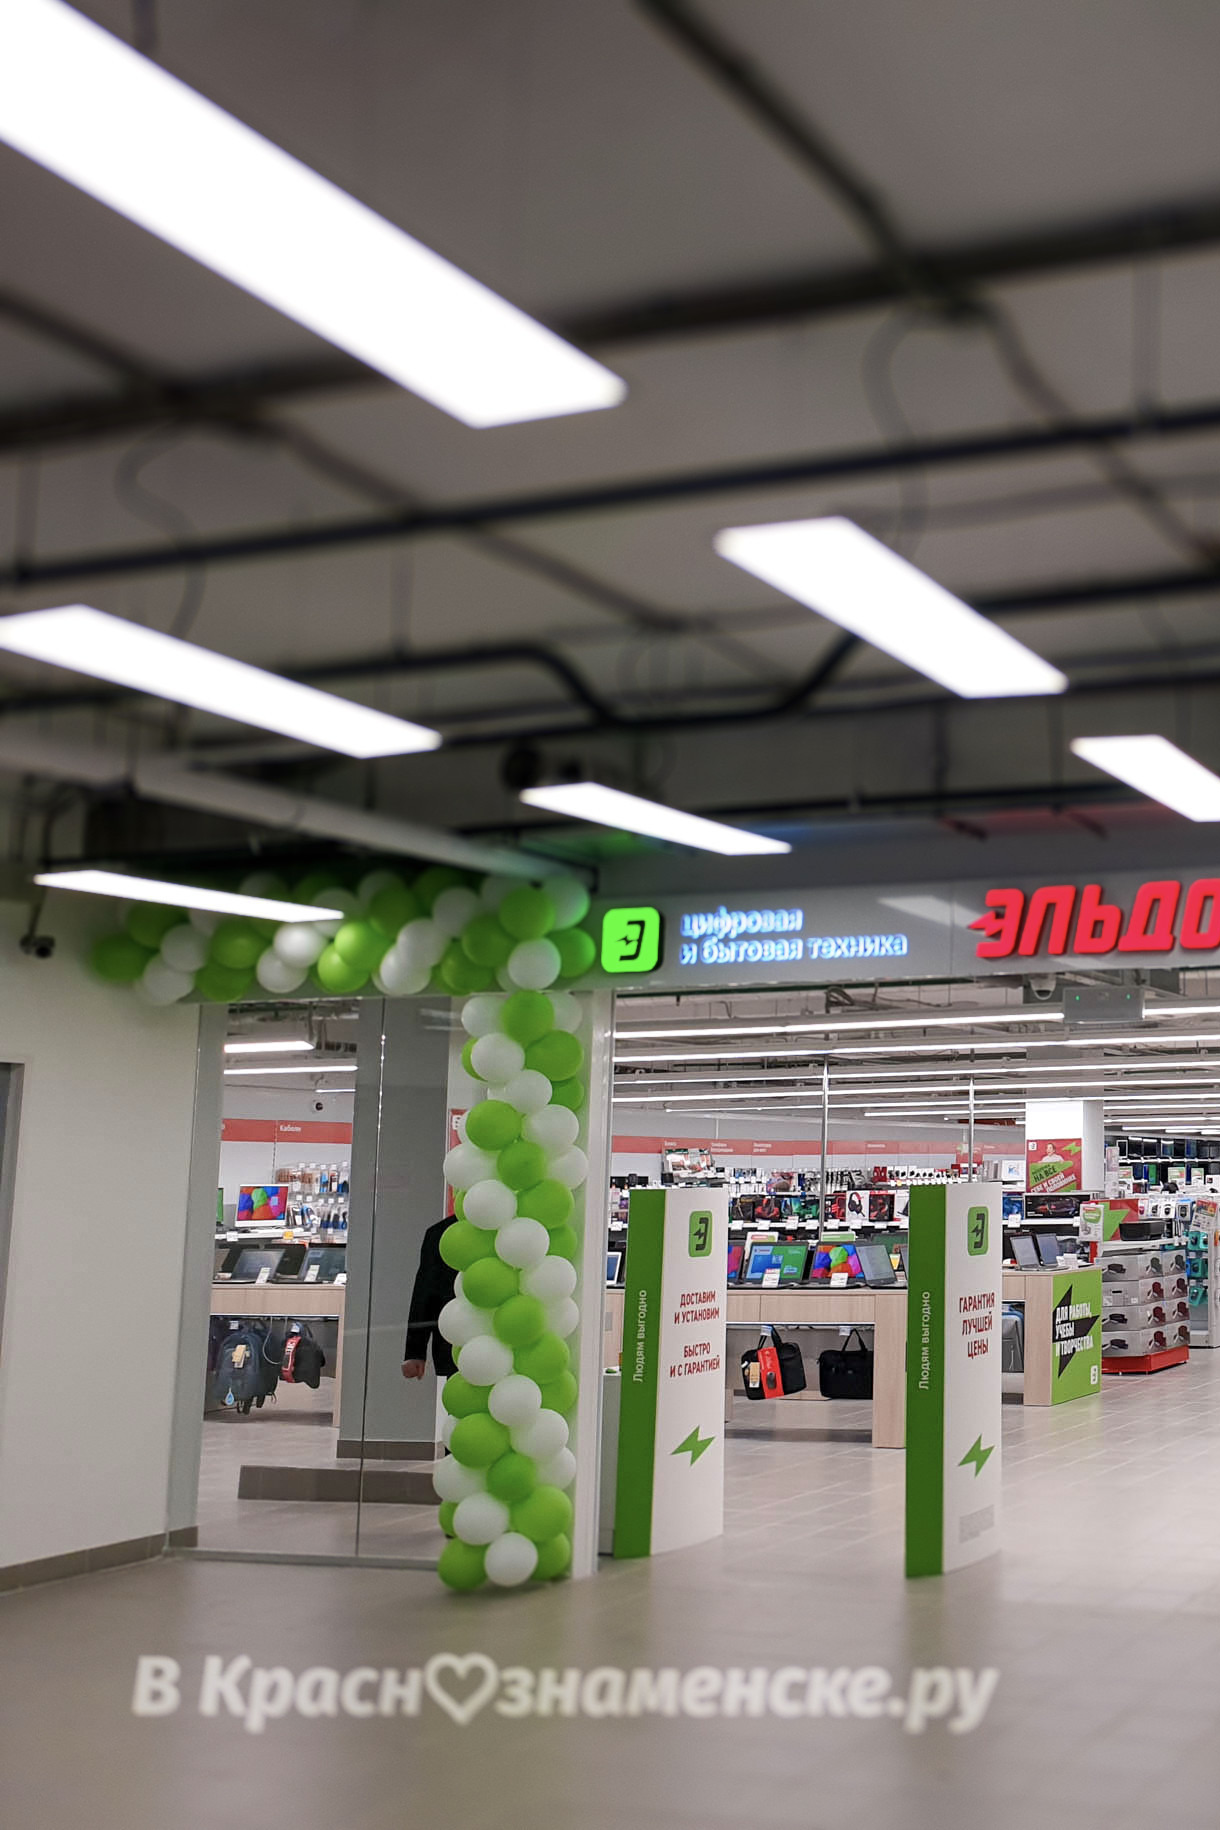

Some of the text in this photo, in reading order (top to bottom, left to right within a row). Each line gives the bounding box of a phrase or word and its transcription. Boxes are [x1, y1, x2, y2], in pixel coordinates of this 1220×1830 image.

[680, 905, 804, 939] цифровая
[680, 933, 909, 965] и бытовая техника
[680, 1290, 716, 1308] ДОСТАВИМ
[959, 1291, 995, 1313] ГАРАНТИЯ
[674, 1307, 720, 1325] И УСТАНОВИМ
[962, 1311, 992, 1336] ЛУЧШЕЙ
[1056, 1306, 1068, 1323] ДЛЯ
[633, 1289, 648, 1382] Людям выгодно
[919, 1291, 931, 1390] Людям выгодно
[1056, 1322, 1075, 1340] УЧЕБЫ
[684, 1342, 711, 1358] БЫСТРО
[967, 1338, 989, 1359] ЦЕНЫ
[670, 1354, 720, 1378] И С ГАРАНТИЕЙ
